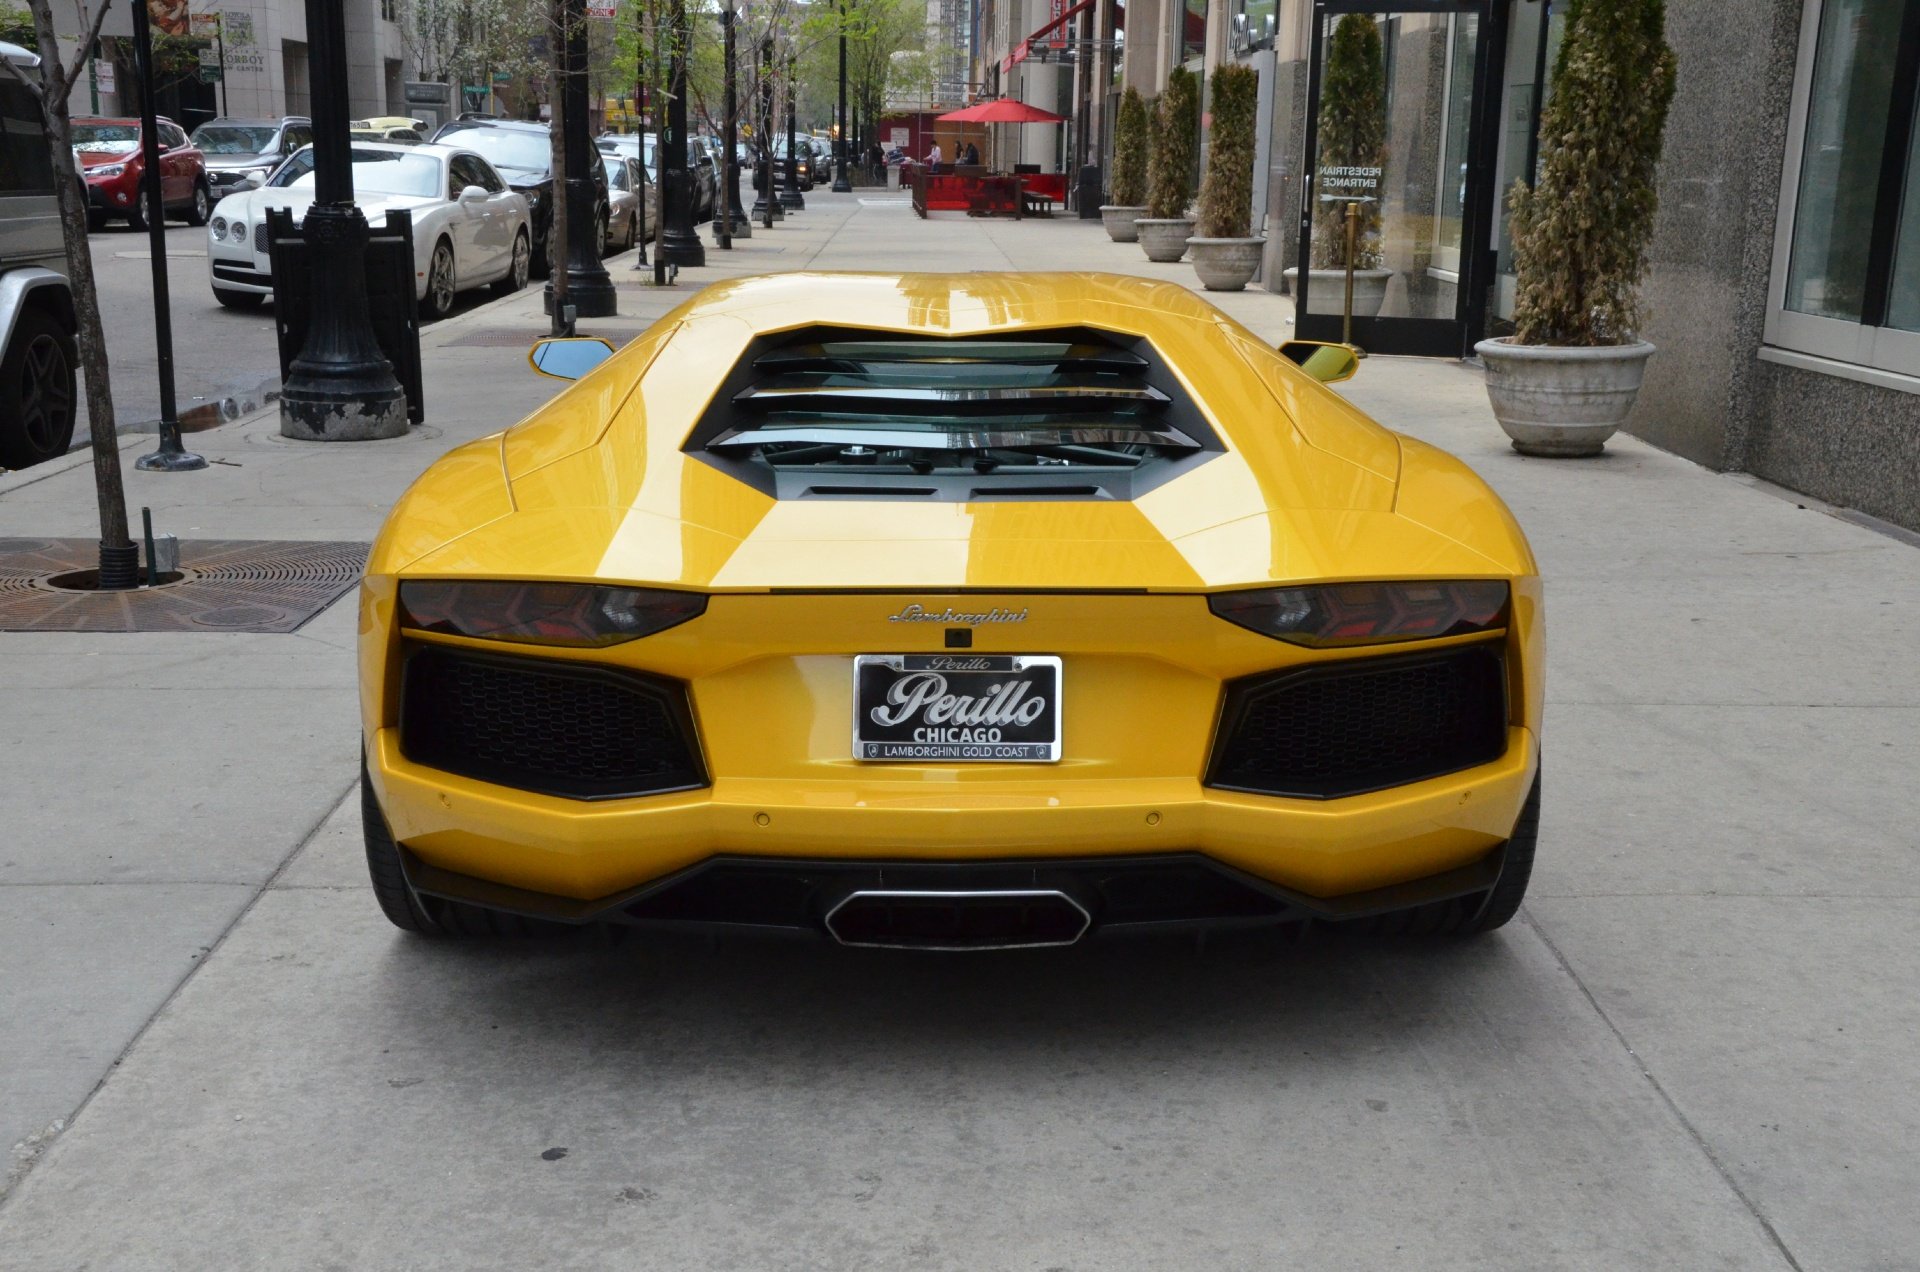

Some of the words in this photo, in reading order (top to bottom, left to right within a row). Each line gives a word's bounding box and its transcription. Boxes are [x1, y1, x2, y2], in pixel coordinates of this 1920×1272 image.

[223, 55, 264, 65] ORBOY
[889, 604, 1028, 627] Lamborghini
[926, 656, 991, 671] Perillo
[870, 672, 1046, 727] Perillo
[913, 728, 1002, 743] CHICAGO
[884, 746, 960, 757] LAMBORGHINI
[962, 746, 992, 757] GOLD
[995, 746, 1030, 757] COAST
